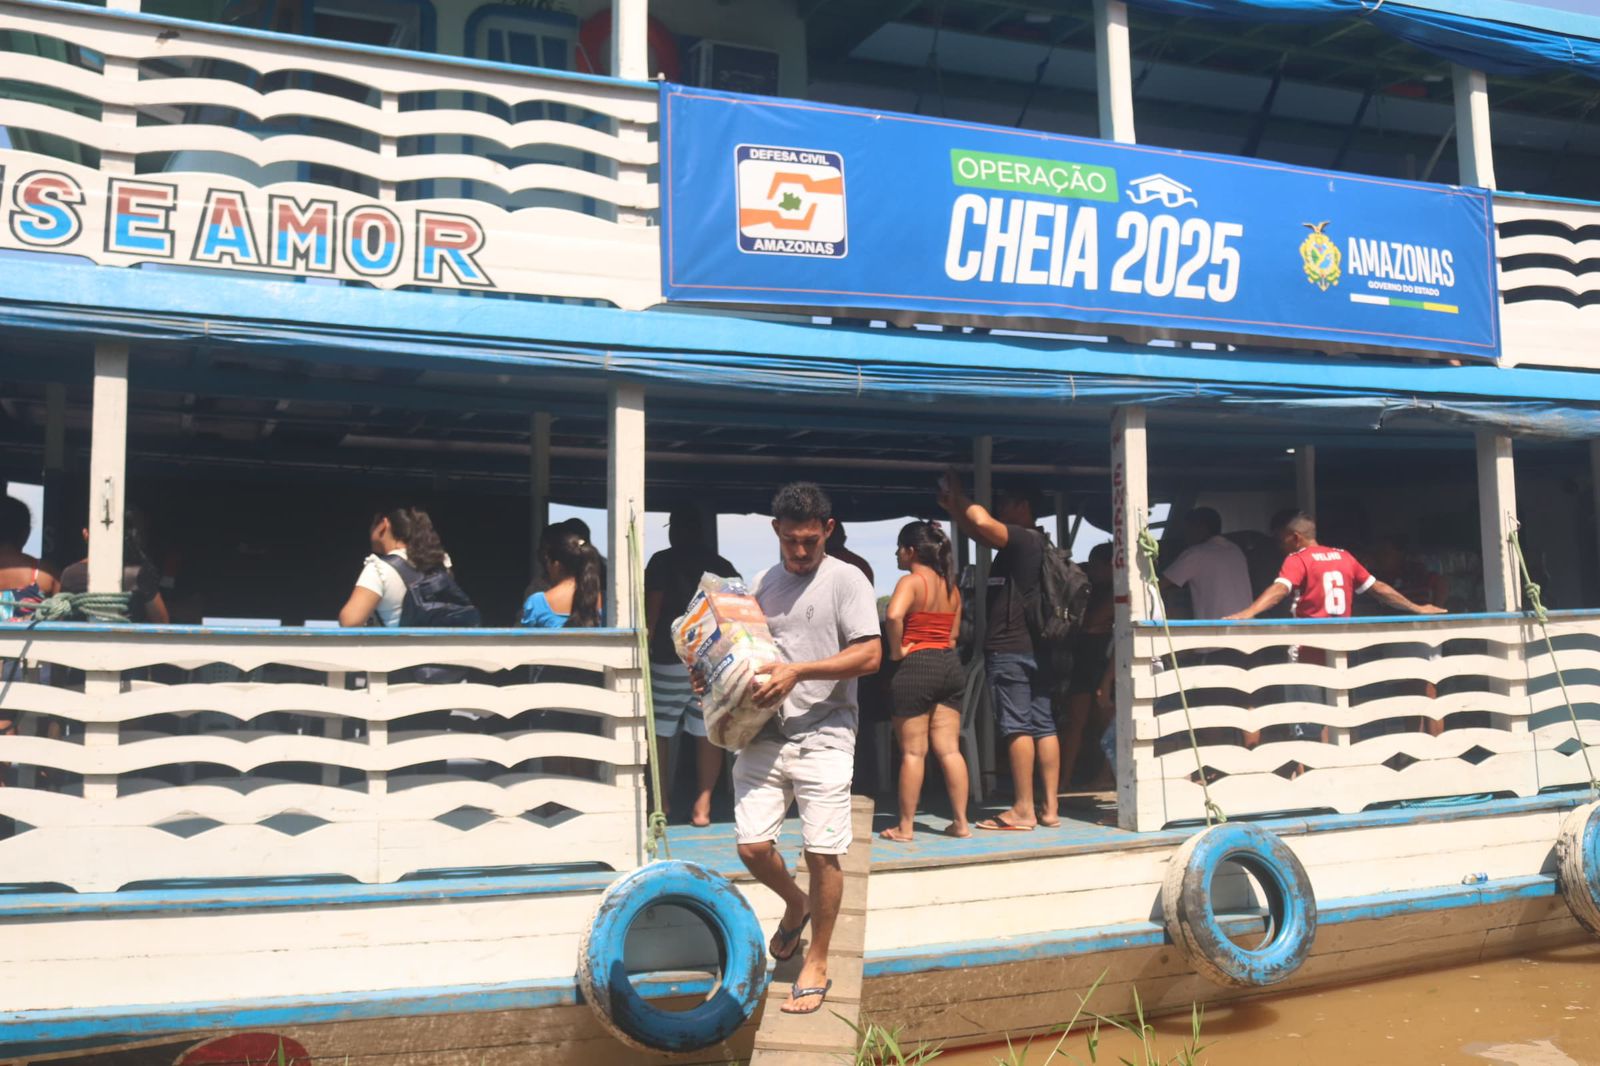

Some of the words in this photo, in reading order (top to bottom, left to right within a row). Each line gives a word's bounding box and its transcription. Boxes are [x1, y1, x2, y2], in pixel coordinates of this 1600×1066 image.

[749, 148, 798, 163] DEFESA
[799, 153, 830, 166] CIVIL
[957, 156, 1108, 194] OPERAÇÃO
[0, 164, 86, 248] S
[190, 187, 498, 288] AMOR
[753, 238, 836, 256] AMAZONAS
[944, 193, 1099, 291] CHEIA
[1109, 210, 1244, 303] 2025
[1347, 236, 1456, 288] AMAZONAS
[1367, 280, 1402, 292] GOVERNO
[1403, 284, 1414, 294] DO
[1414, 286, 1440, 297] ESTADO
[1322, 569, 1347, 616] 6
